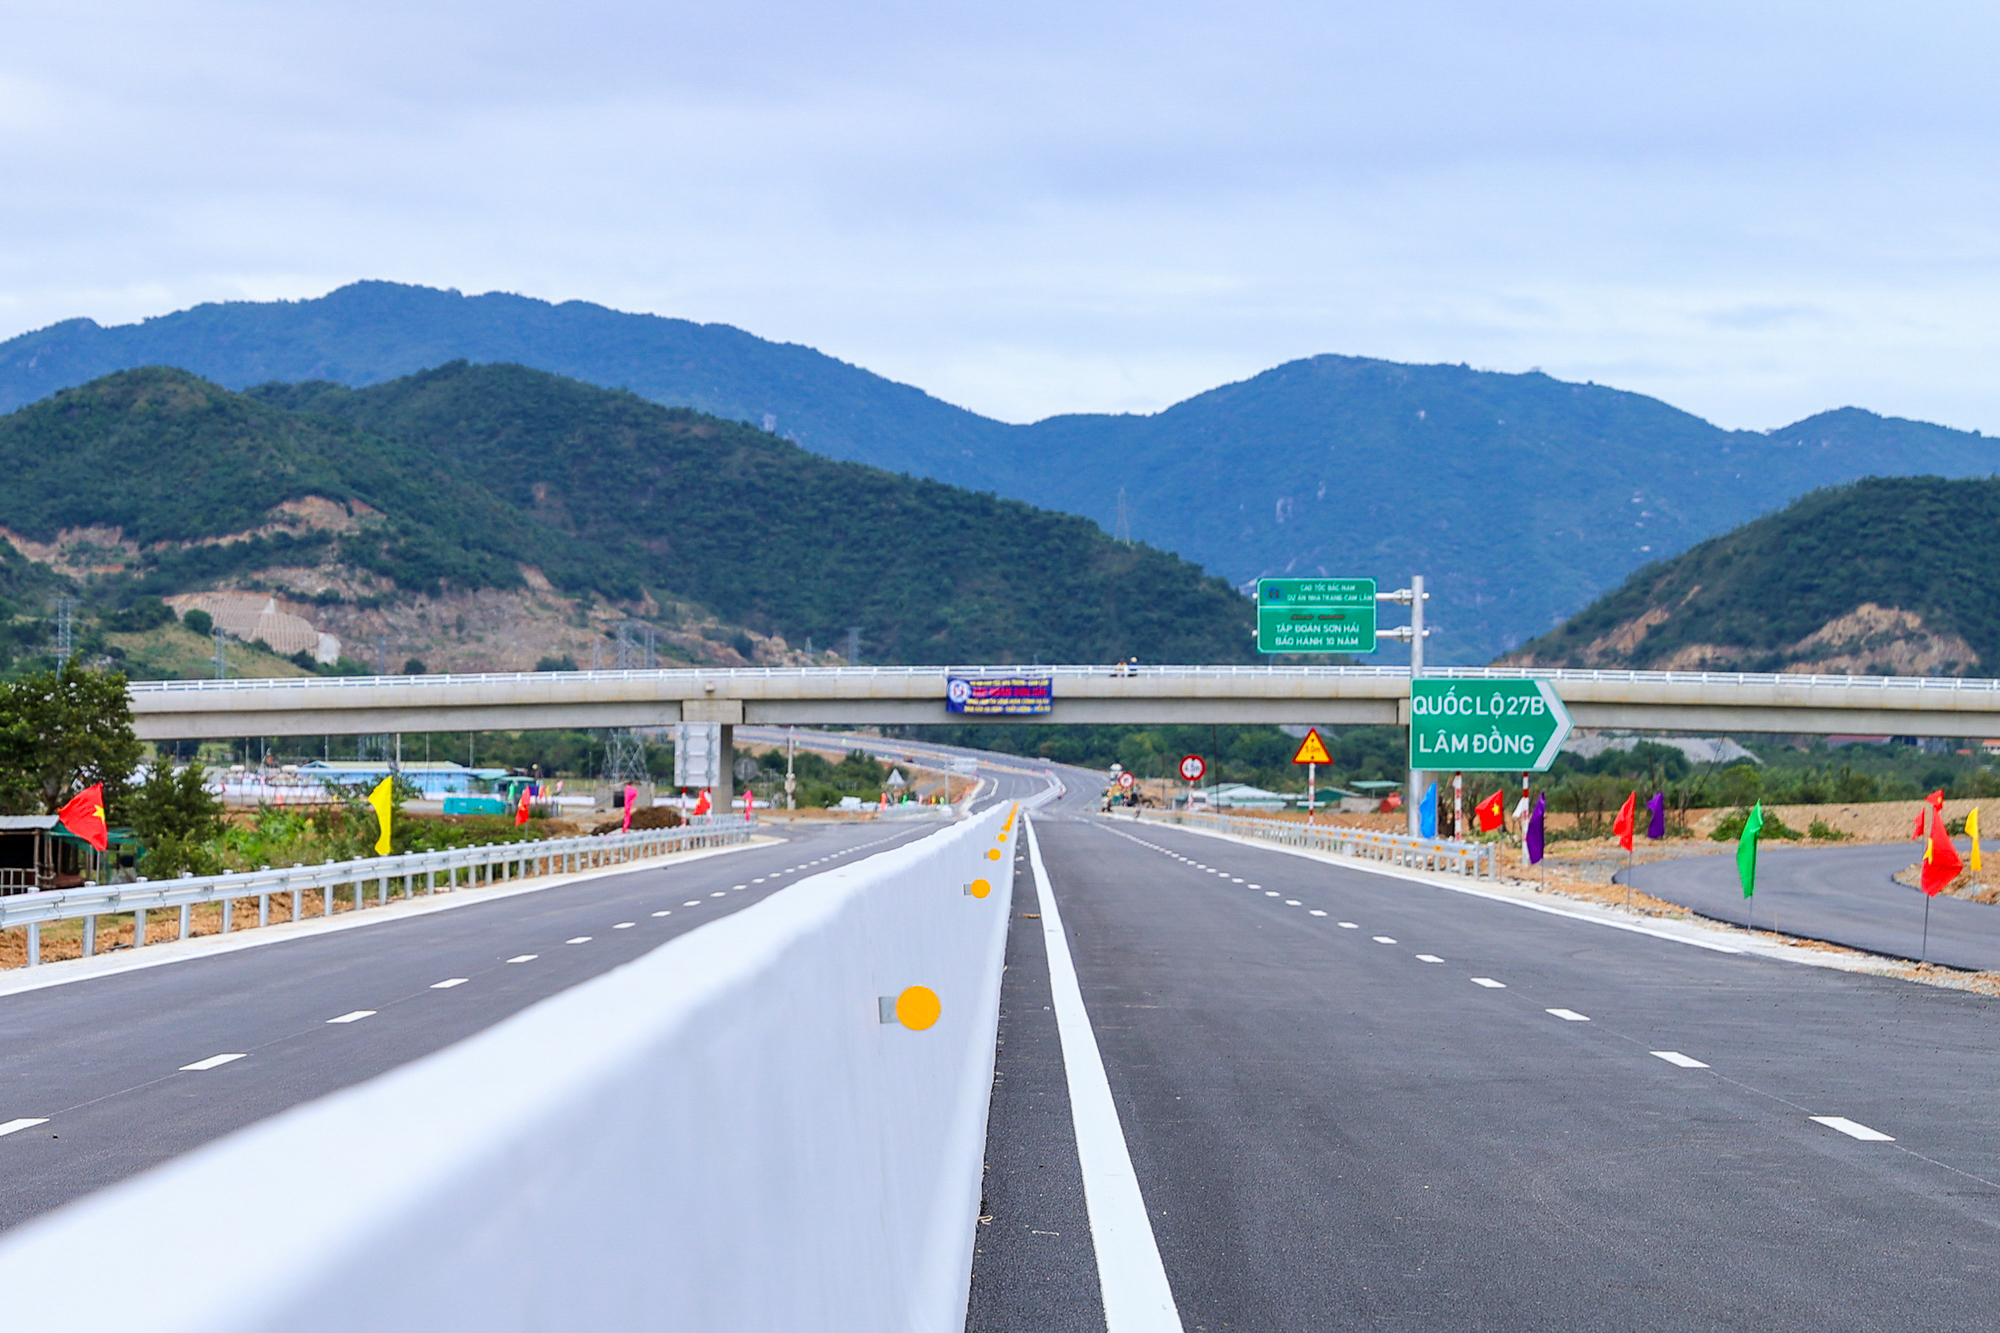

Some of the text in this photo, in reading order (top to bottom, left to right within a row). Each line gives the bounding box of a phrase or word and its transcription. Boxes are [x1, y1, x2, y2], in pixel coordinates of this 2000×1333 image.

[1413, 685, 1545, 719] QUỐC LỘ 27B
[1419, 725, 1535, 754] LÂM ĐỒNG
